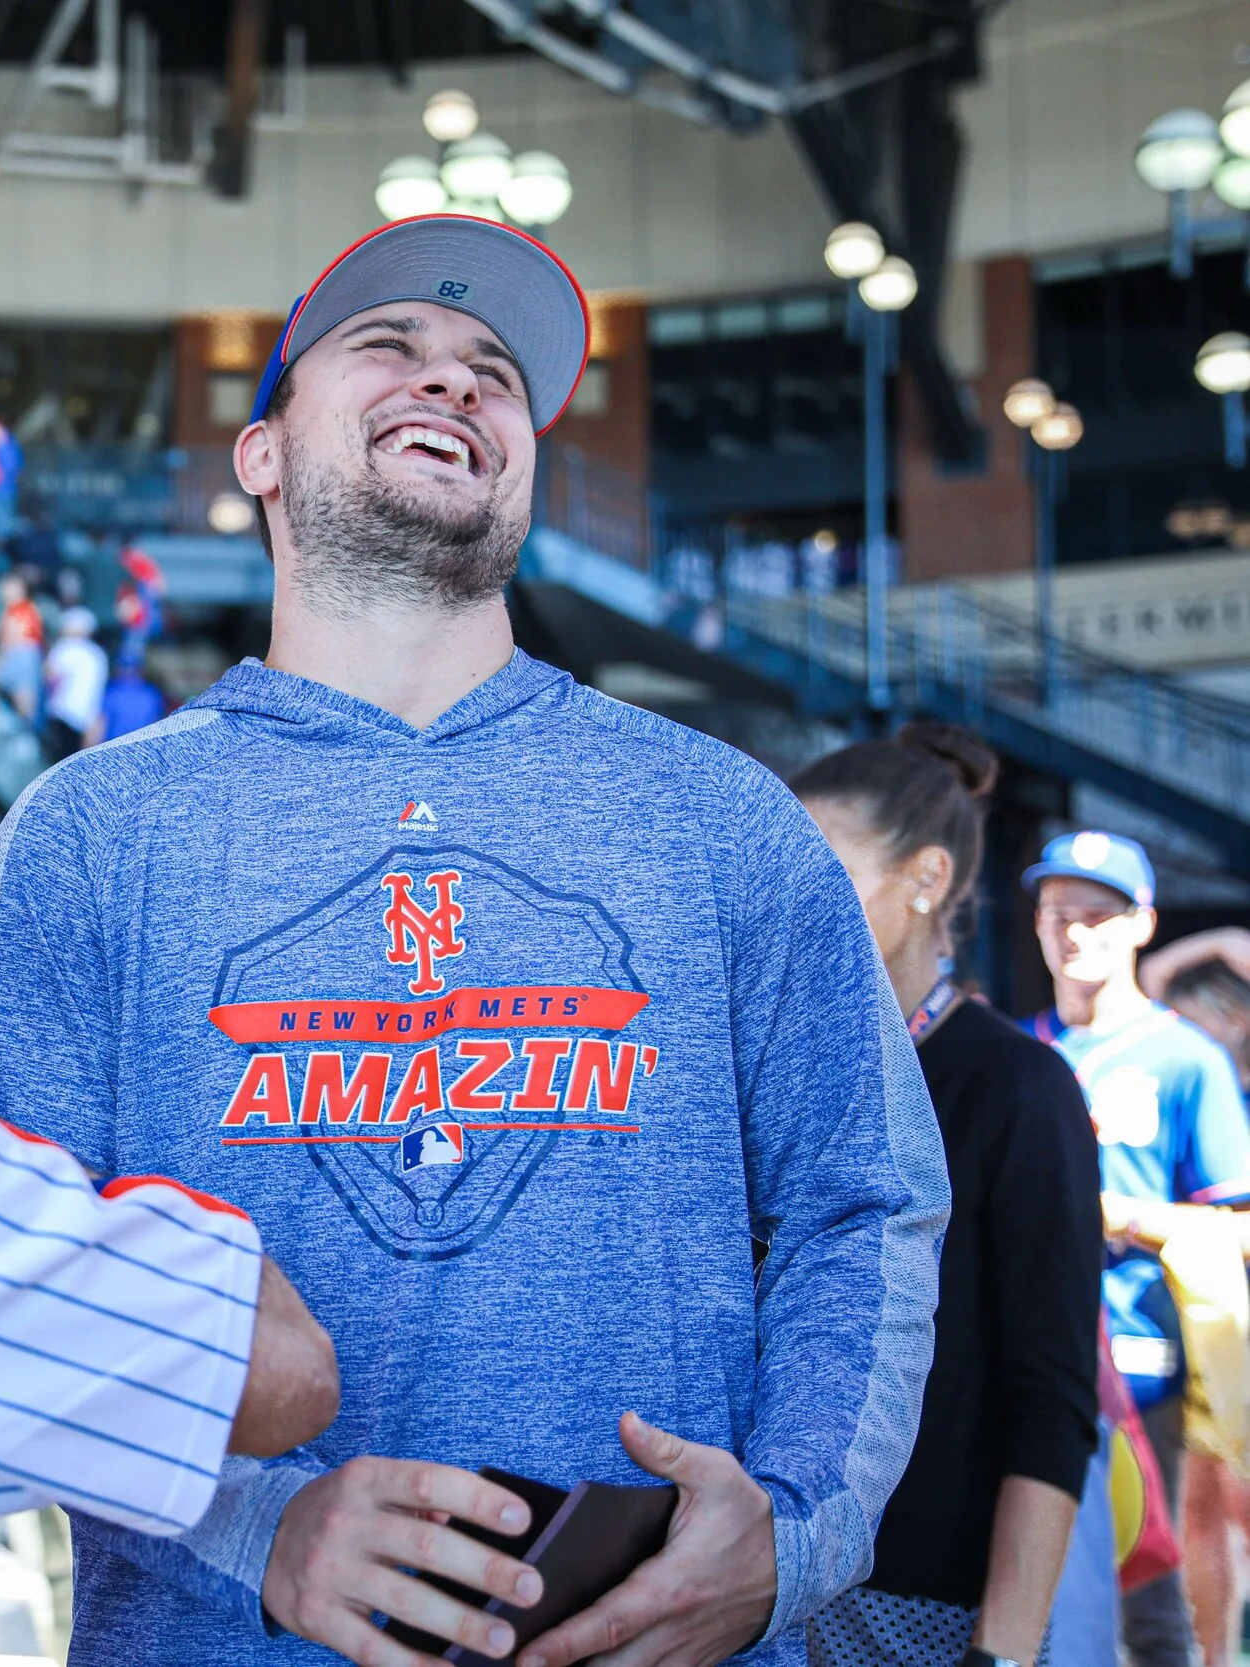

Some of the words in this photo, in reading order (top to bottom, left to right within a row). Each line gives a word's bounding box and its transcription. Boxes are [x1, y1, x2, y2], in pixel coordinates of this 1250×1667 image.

[398, 821, 439, 832] Majestic
[279, 1010, 356, 1032] NEW
[376, 1000, 456, 1034] YORK
[219, 1038, 660, 1127] AMAZIN'
